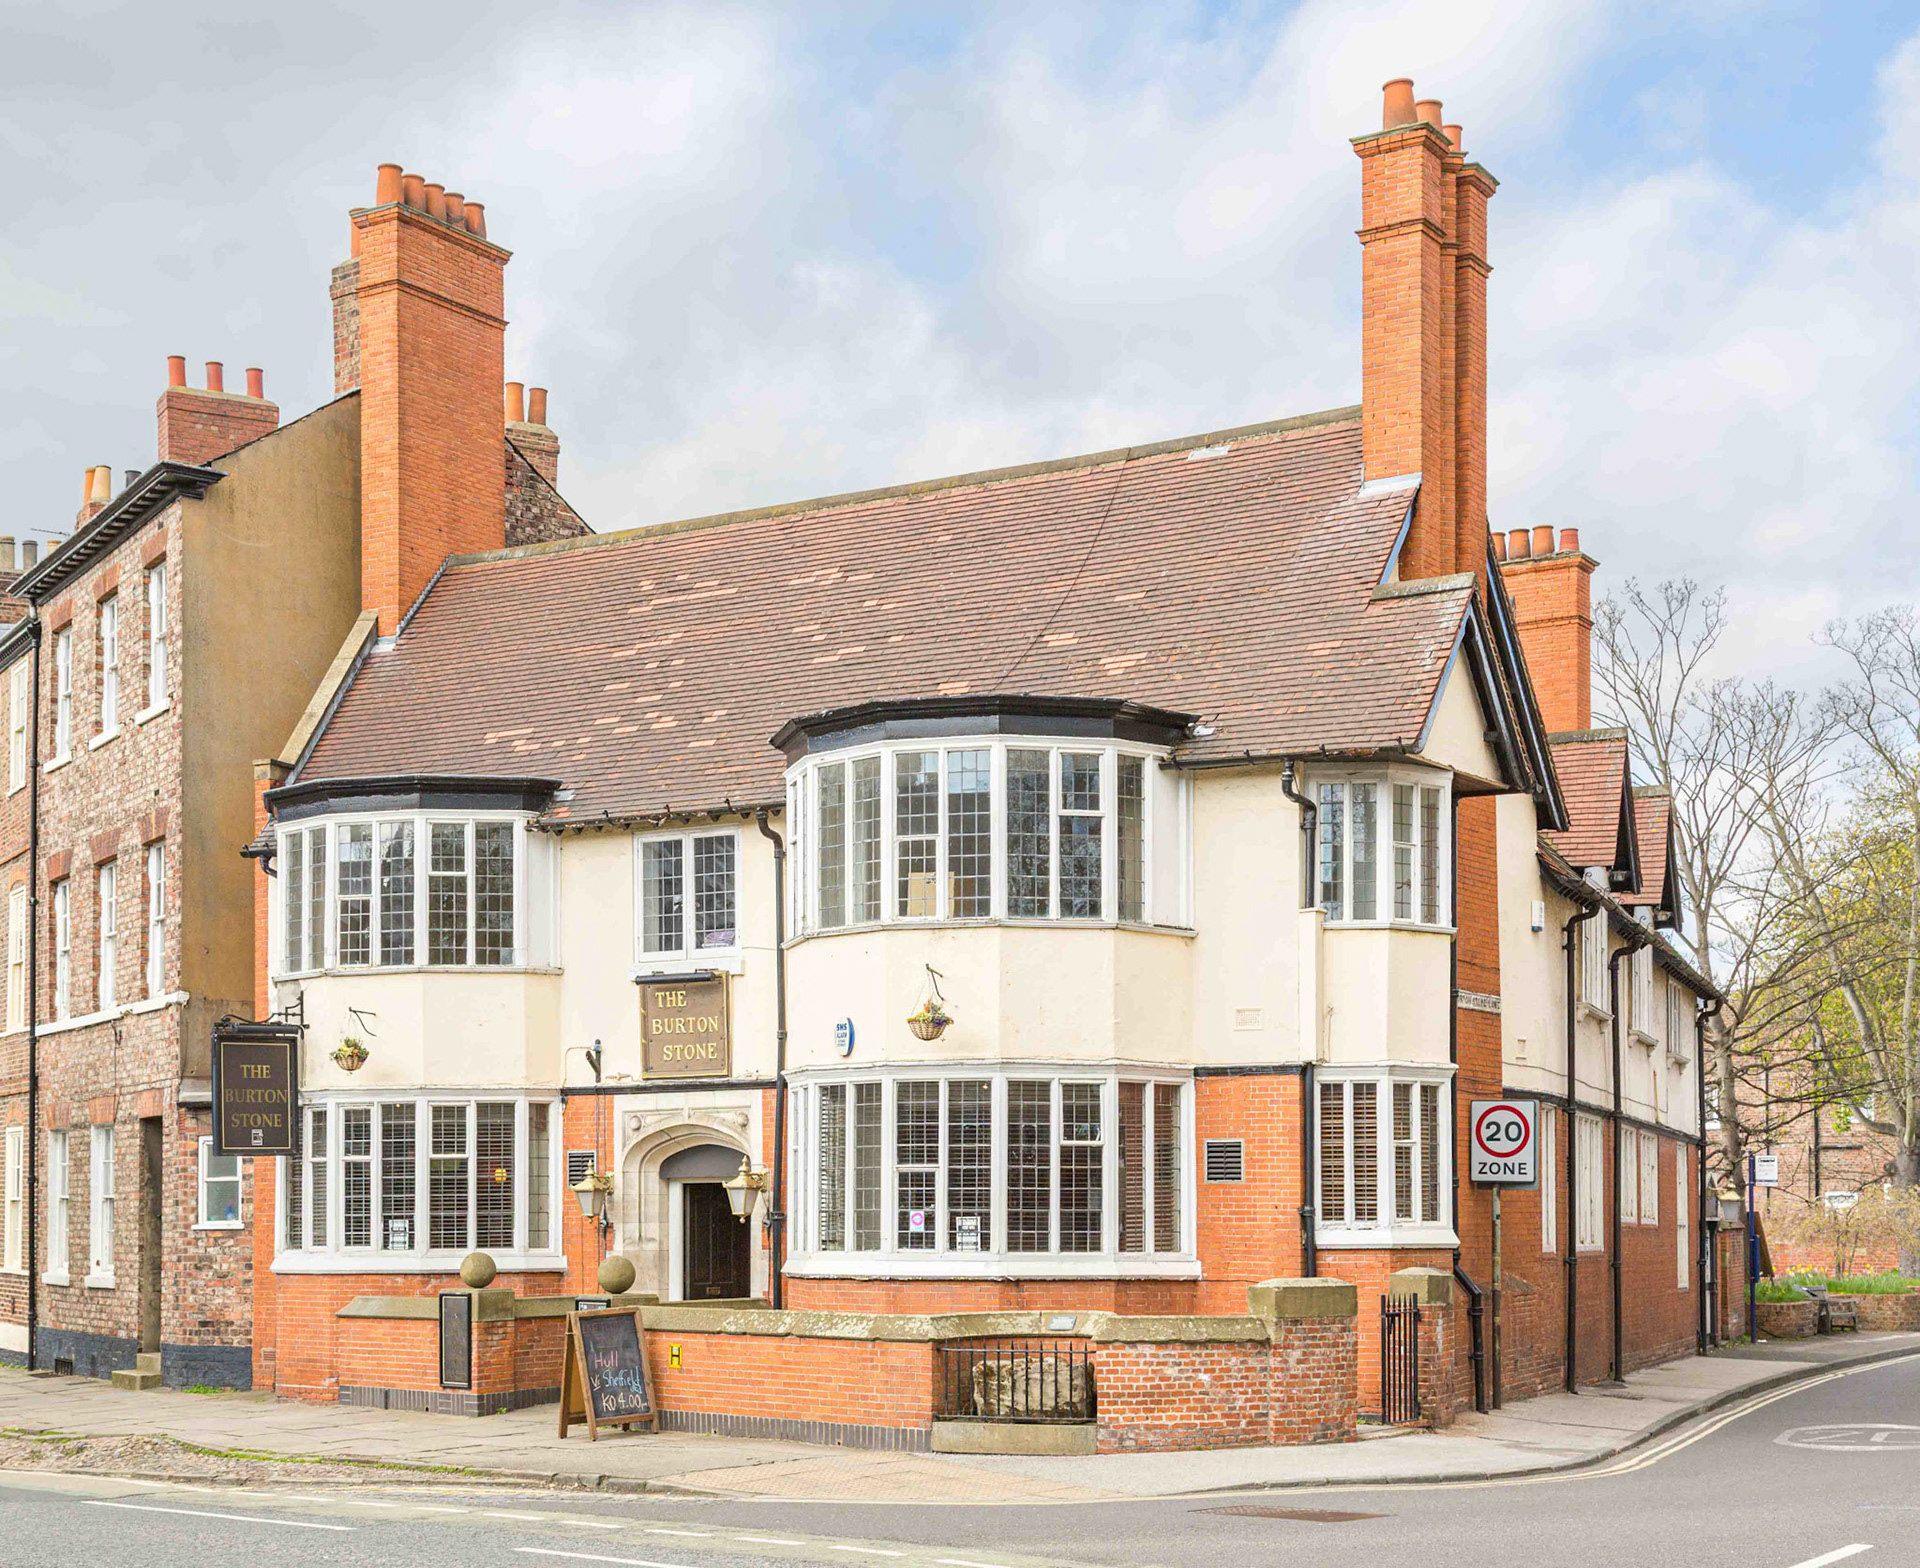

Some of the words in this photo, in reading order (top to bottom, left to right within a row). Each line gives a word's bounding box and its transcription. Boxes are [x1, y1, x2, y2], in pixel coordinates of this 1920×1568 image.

[655, 991, 687, 1008] THE
[652, 1015, 719, 1035] BURTON
[663, 1043, 718, 1061] STONE
[241, 1065, 271, 1078] THE
[225, 1089, 288, 1103] BURTON
[231, 1113, 282, 1127] STONE
[1485, 1121, 1523, 1142] 20
[1478, 1162, 1528, 1175] ZONE
[594, 1351, 618, 1369] Hull
[602, 1366, 641, 1387] Sheffield
[602, 1393, 617, 1412] KO
